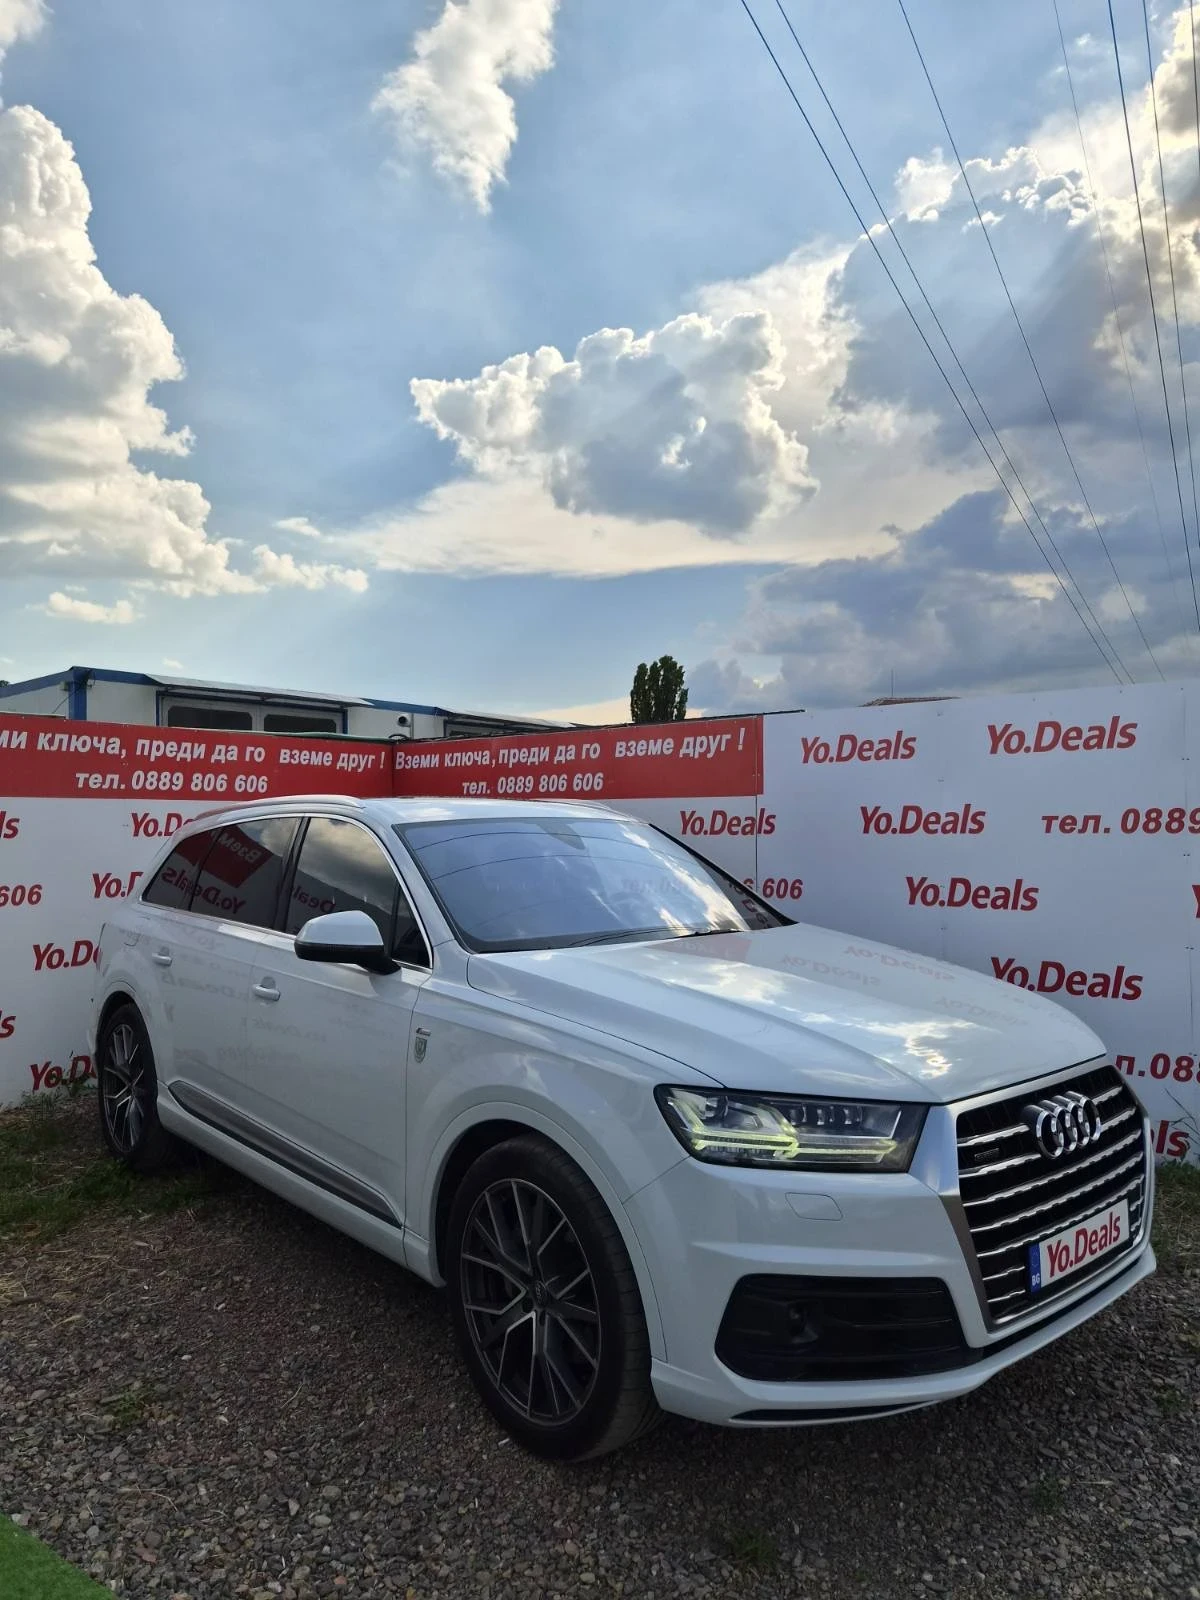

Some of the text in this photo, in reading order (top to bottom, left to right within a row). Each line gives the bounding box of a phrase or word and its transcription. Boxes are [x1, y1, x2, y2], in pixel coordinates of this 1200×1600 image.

[395, 751, 440, 769] Вземи
[444, 750, 496, 768] ключа,
[498, 747, 550, 768] преди
[554, 745, 576, 763] да
[581, 743, 601, 761] го
[615, 738, 674, 758] вземе
[679, 734, 732, 759] друг
[801, 731, 917, 765] Yo.Deals
[988, 716, 1138, 755] Yo.Deals
[37, 732, 127, 759] ключа,
[136, 739, 206, 762] преди
[211, 745, 238, 764] да
[245, 745, 266, 763] го
[279, 749, 333, 766] вземе
[336, 750, 376, 772] друг
[76, 770, 268, 793] тел. 0889 806 606
[462, 772, 604, 795] тел. 0889 806 606
[680, 808, 777, 836] Yo.Deals
[861, 804, 986, 835] Yo.Deals
[1042, 815, 1111, 834] тел.
[762, 878, 803, 900] 606
[906, 876, 1039, 912] Yo.Deals
[990, 956, 1143, 1001] Yo.Deals
[1046, 1211, 1121, 1278] Yo.Deals
[1031, 1273, 1040, 1287] BG
